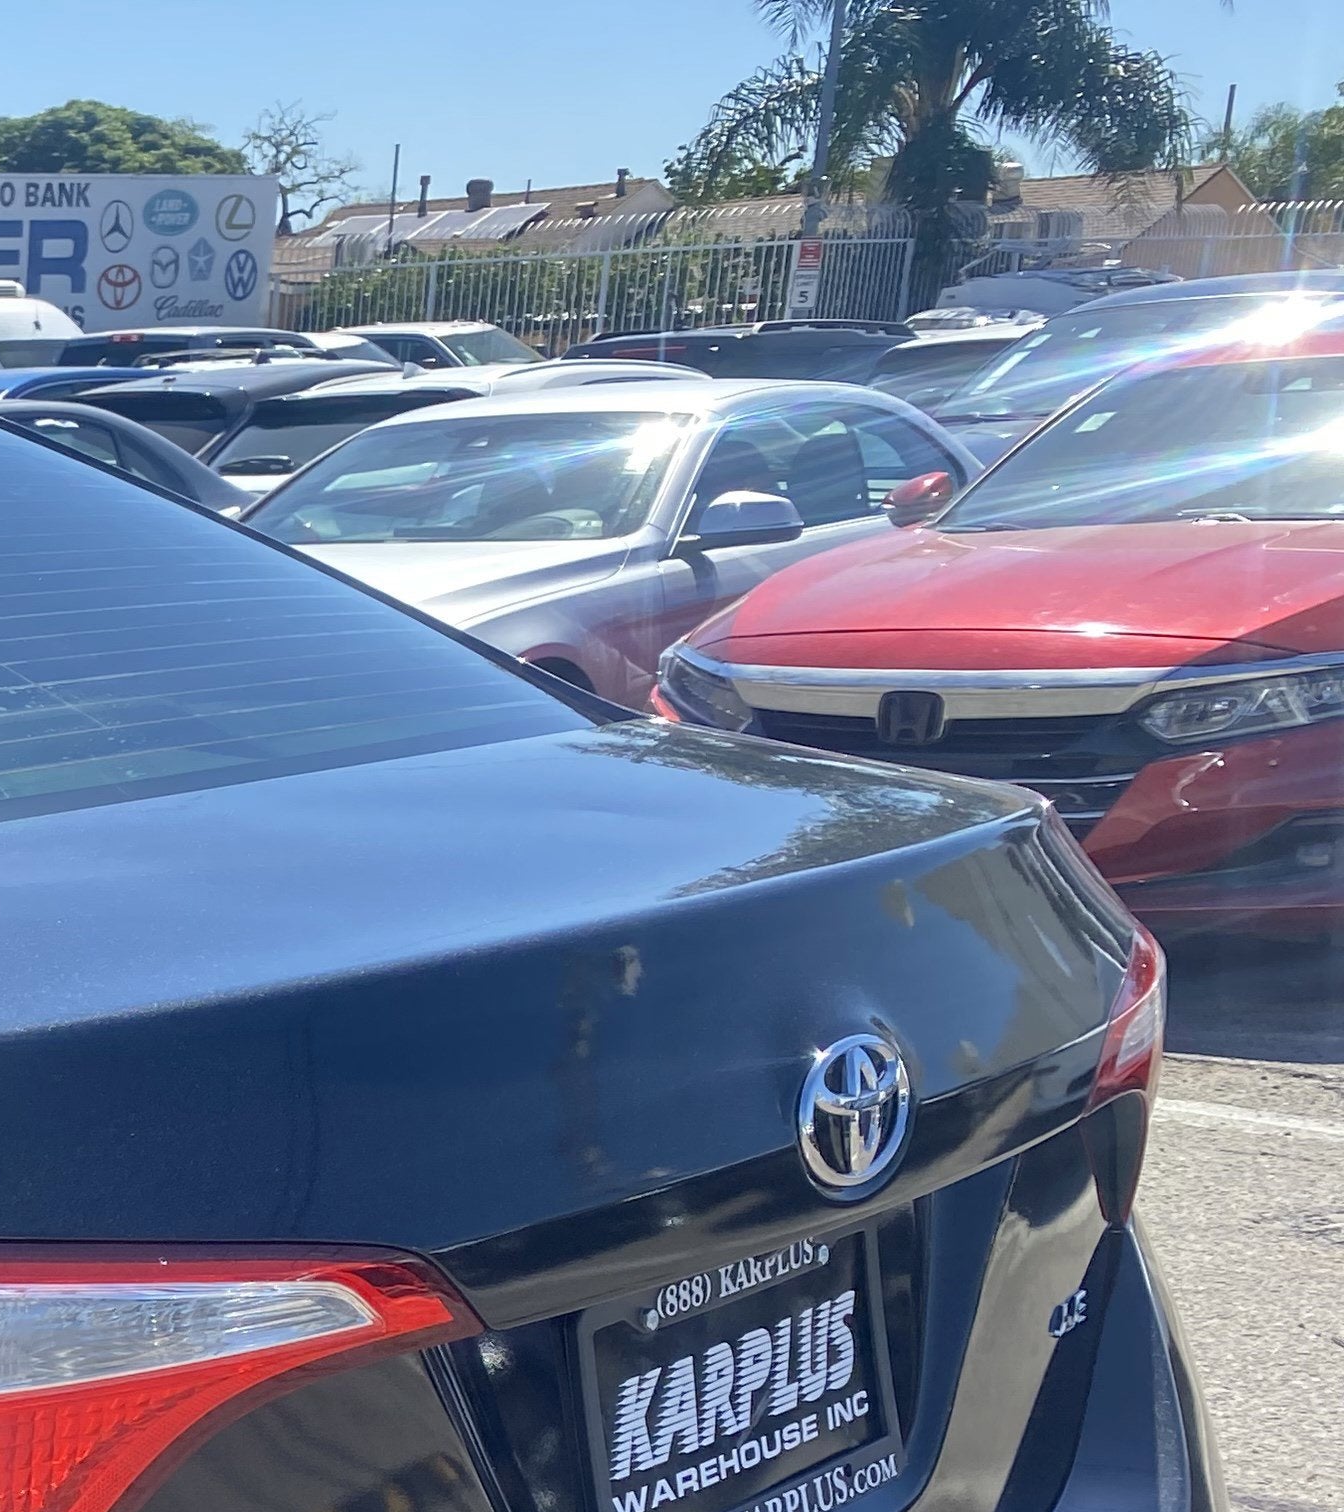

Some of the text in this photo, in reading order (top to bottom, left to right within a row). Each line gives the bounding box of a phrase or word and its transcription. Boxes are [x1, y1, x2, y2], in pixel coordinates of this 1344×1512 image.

[24, 182, 91, 209] BANK
[153, 294, 224, 321] Cadillac
[798, 290, 809, 303] 5
[656, 1274, 712, 1319] (888)
[609, 1289, 856, 1482] KARPLUS
[826, 1390, 870, 1432] INC
